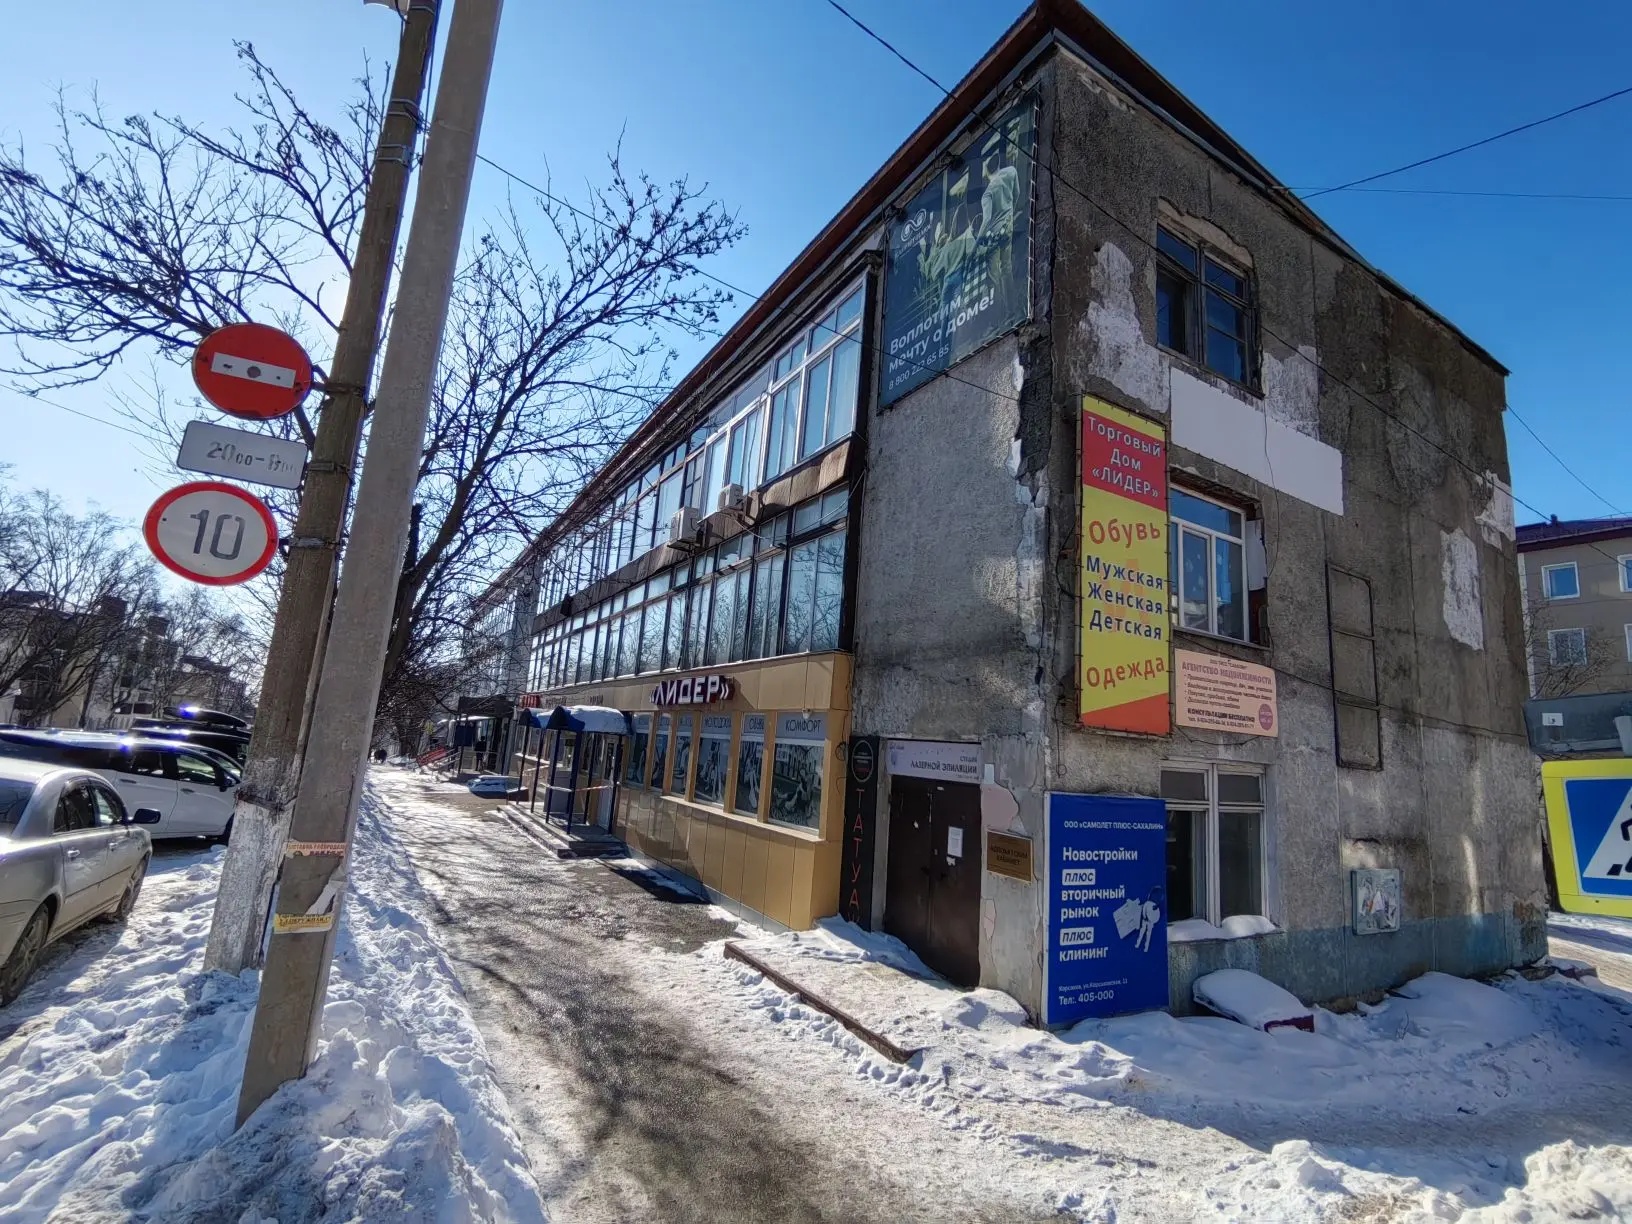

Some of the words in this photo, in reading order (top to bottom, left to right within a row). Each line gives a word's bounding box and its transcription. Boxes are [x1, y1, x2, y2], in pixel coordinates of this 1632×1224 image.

[889, 335, 930, 374] мечту
[945, 287, 995, 338] доме!
[890, 294, 962, 355] Воплотим
[888, 381, 895, 391] 8
[895, 370, 910, 386] 800
[926, 351, 937, 366] 65
[1088, 416, 1160, 457] Торговый
[1110, 448, 1141, 471] Дом
[1092, 467, 1159, 497] «ЛИДЕР»
[189, 509, 246, 561] 10
[1088, 518, 1161, 548] Обувь
[1086, 554, 1163, 590] Мужская
[1087, 581, 1163, 615] Женская
[1089, 609, 1162, 641] Детская
[1086, 656, 1165, 691] Одежда
[1182, 661, 1219, 676] АГЕНТСТВО
[650, 675, 730, 706] «ЛИДЕР»
[785, 719, 821, 733] КОМФОРТ
[910, 760, 941, 771] ЛАЗЕРНОЙ
[942, 762, 977, 774] ЭПИЛЯЦИИ
[1063, 820, 1078, 829] ООО
[1063, 846, 1138, 865] Новостройки
[1061, 885, 1125, 904] вторичный
[1061, 906, 1100, 923] рынок
[1059, 946, 1109, 962] клининг
[1078, 990, 1115, 1003] 405-000
